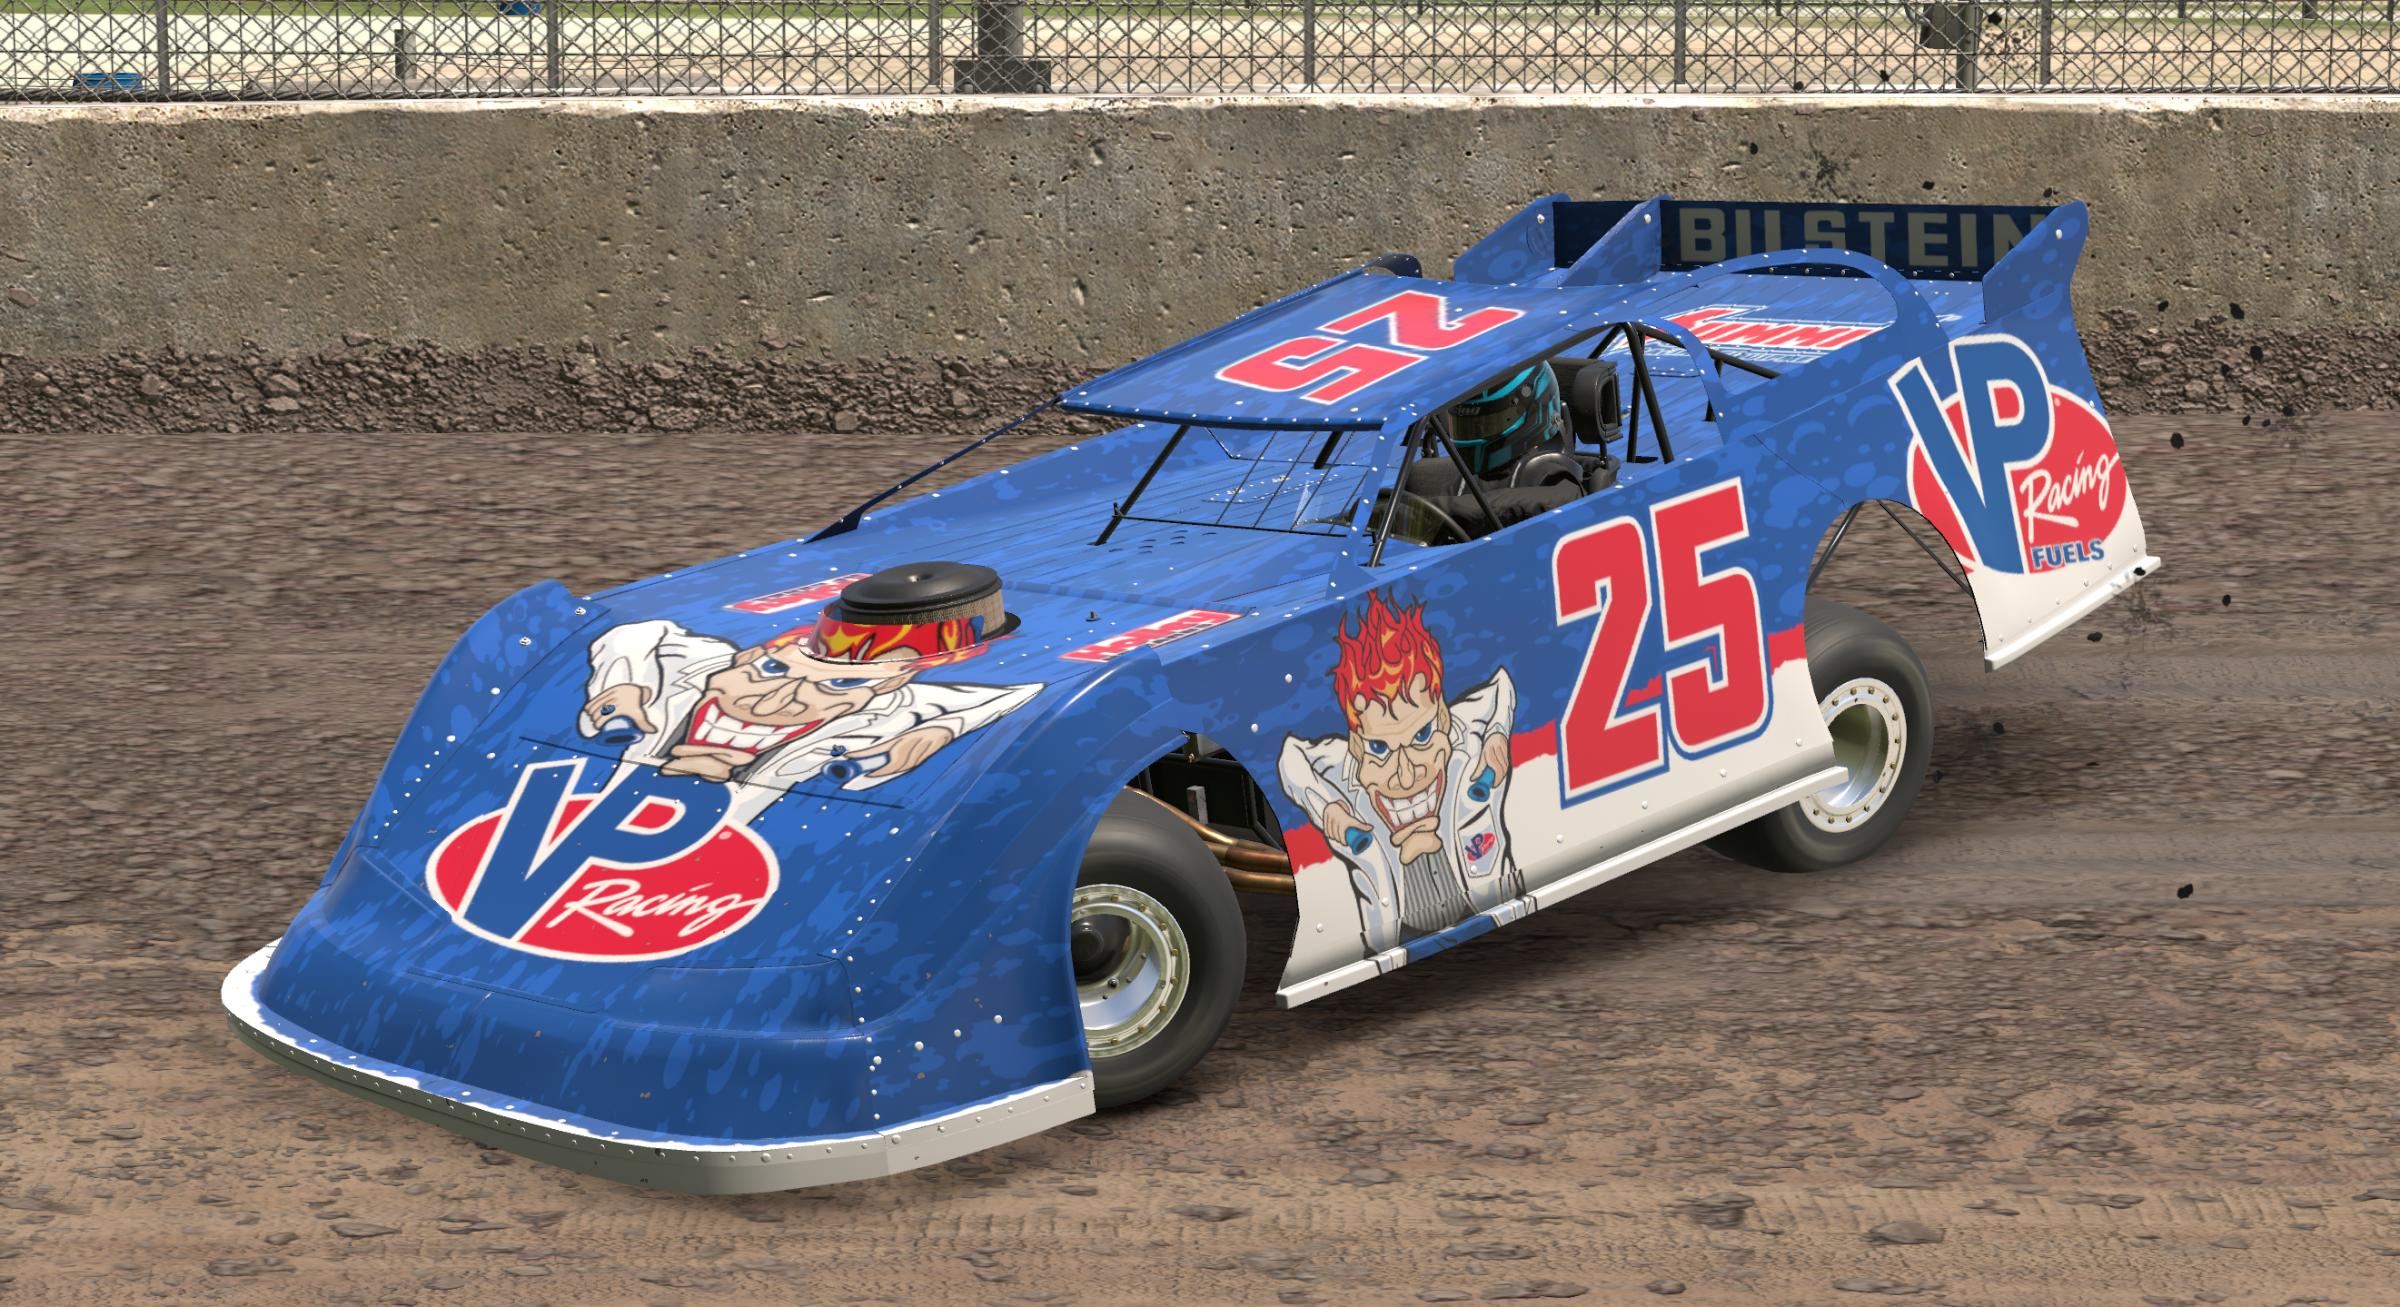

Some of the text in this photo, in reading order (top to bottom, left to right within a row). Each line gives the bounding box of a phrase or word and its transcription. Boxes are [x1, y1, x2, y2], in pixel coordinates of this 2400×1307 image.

[1215, 290, 1526, 405] 25
[1612, 305, 1886, 350] SUMMI
[1889, 333, 2055, 574] VP
[2020, 451, 2119, 543] Racing
[2031, 539, 2105, 570] FUELS
[1552, 476, 1772, 804] 25
[459, 758, 733, 943] VP
[546, 878, 765, 938] Racing
